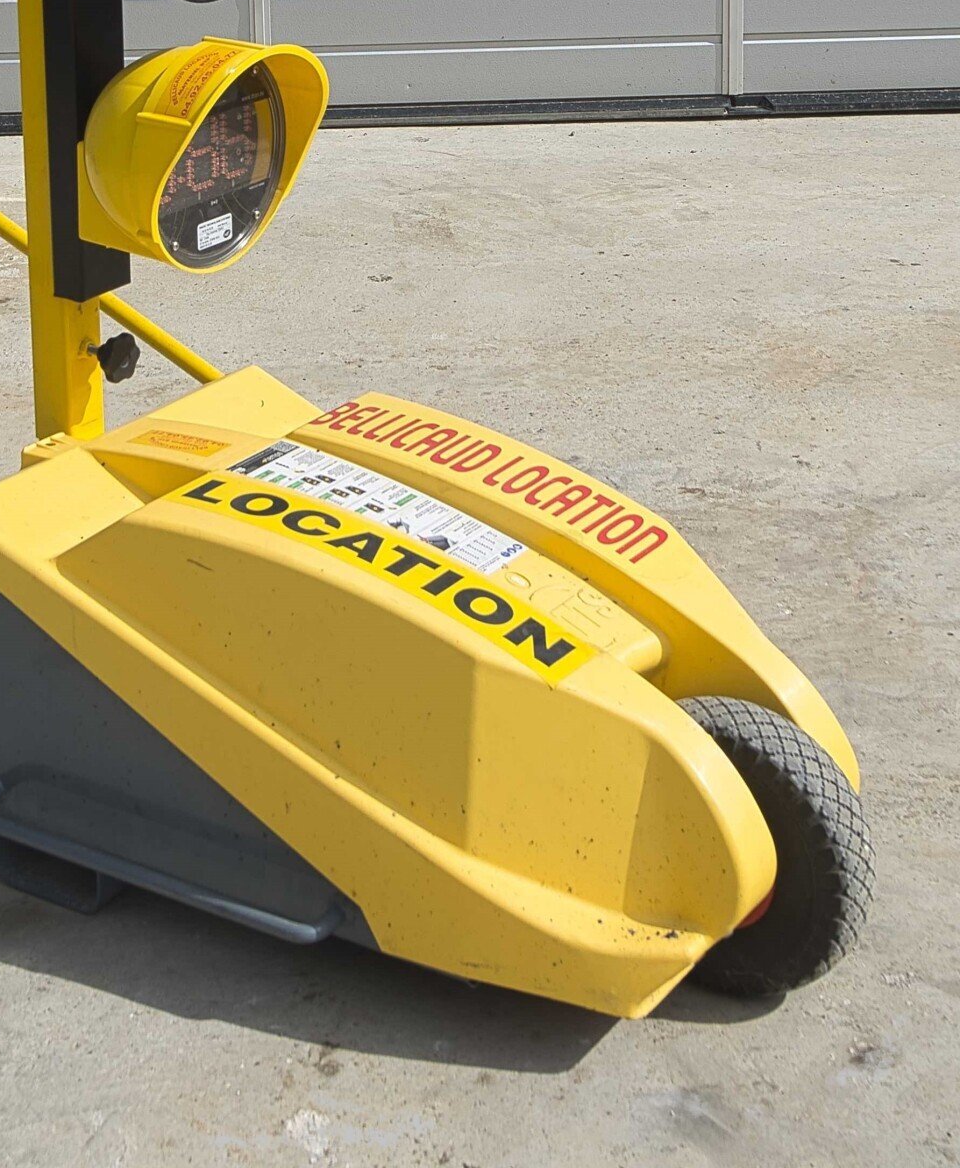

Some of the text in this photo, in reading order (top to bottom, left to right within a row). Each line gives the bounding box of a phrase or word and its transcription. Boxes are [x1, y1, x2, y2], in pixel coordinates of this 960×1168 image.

[308, 402, 502, 473] BELLICAUD
[482, 456, 669, 565] LOCATION
[181, 479, 577, 668] LOCATION
